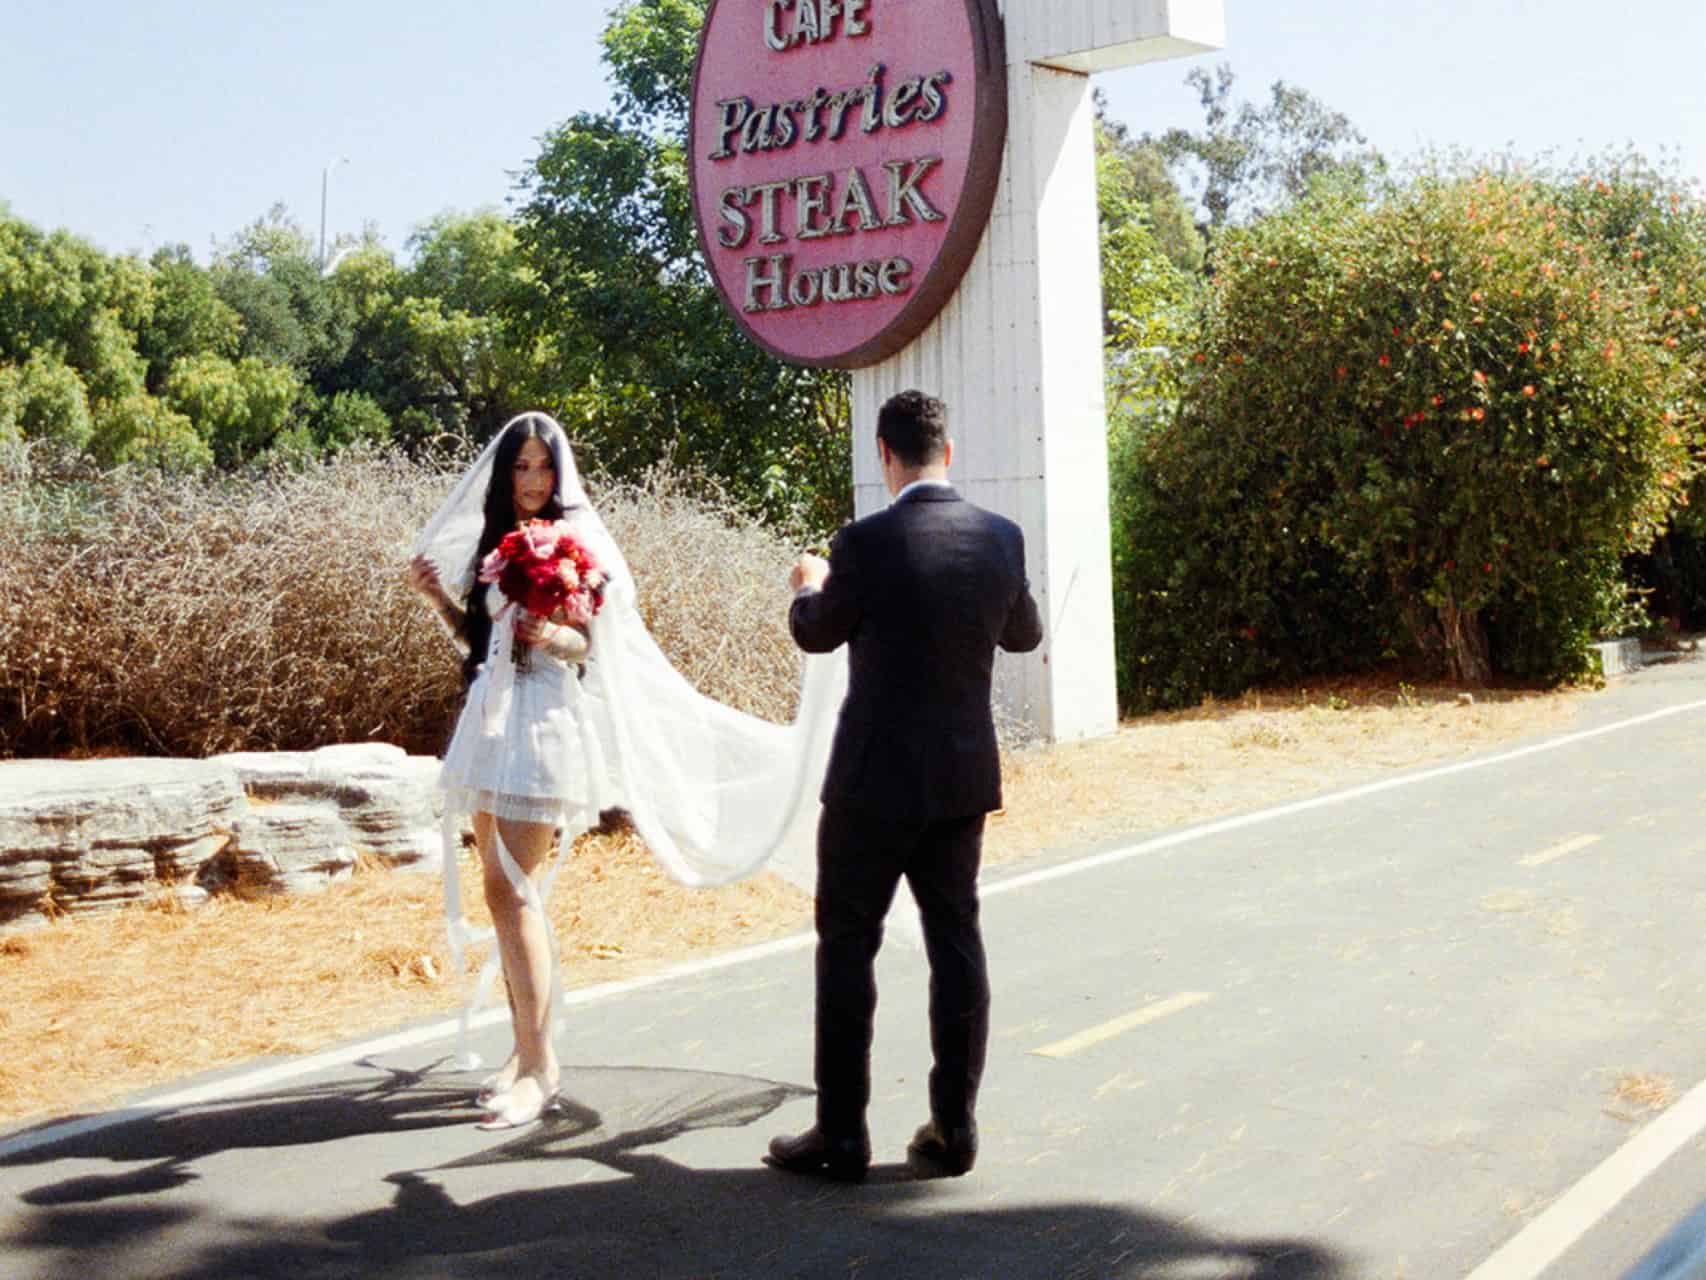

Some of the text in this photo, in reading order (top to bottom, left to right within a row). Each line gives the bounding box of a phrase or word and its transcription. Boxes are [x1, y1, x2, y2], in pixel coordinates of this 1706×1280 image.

[709, 63, 953, 160] Pastries
[718, 156, 945, 250] STEAK
[743, 252, 913, 314] House
